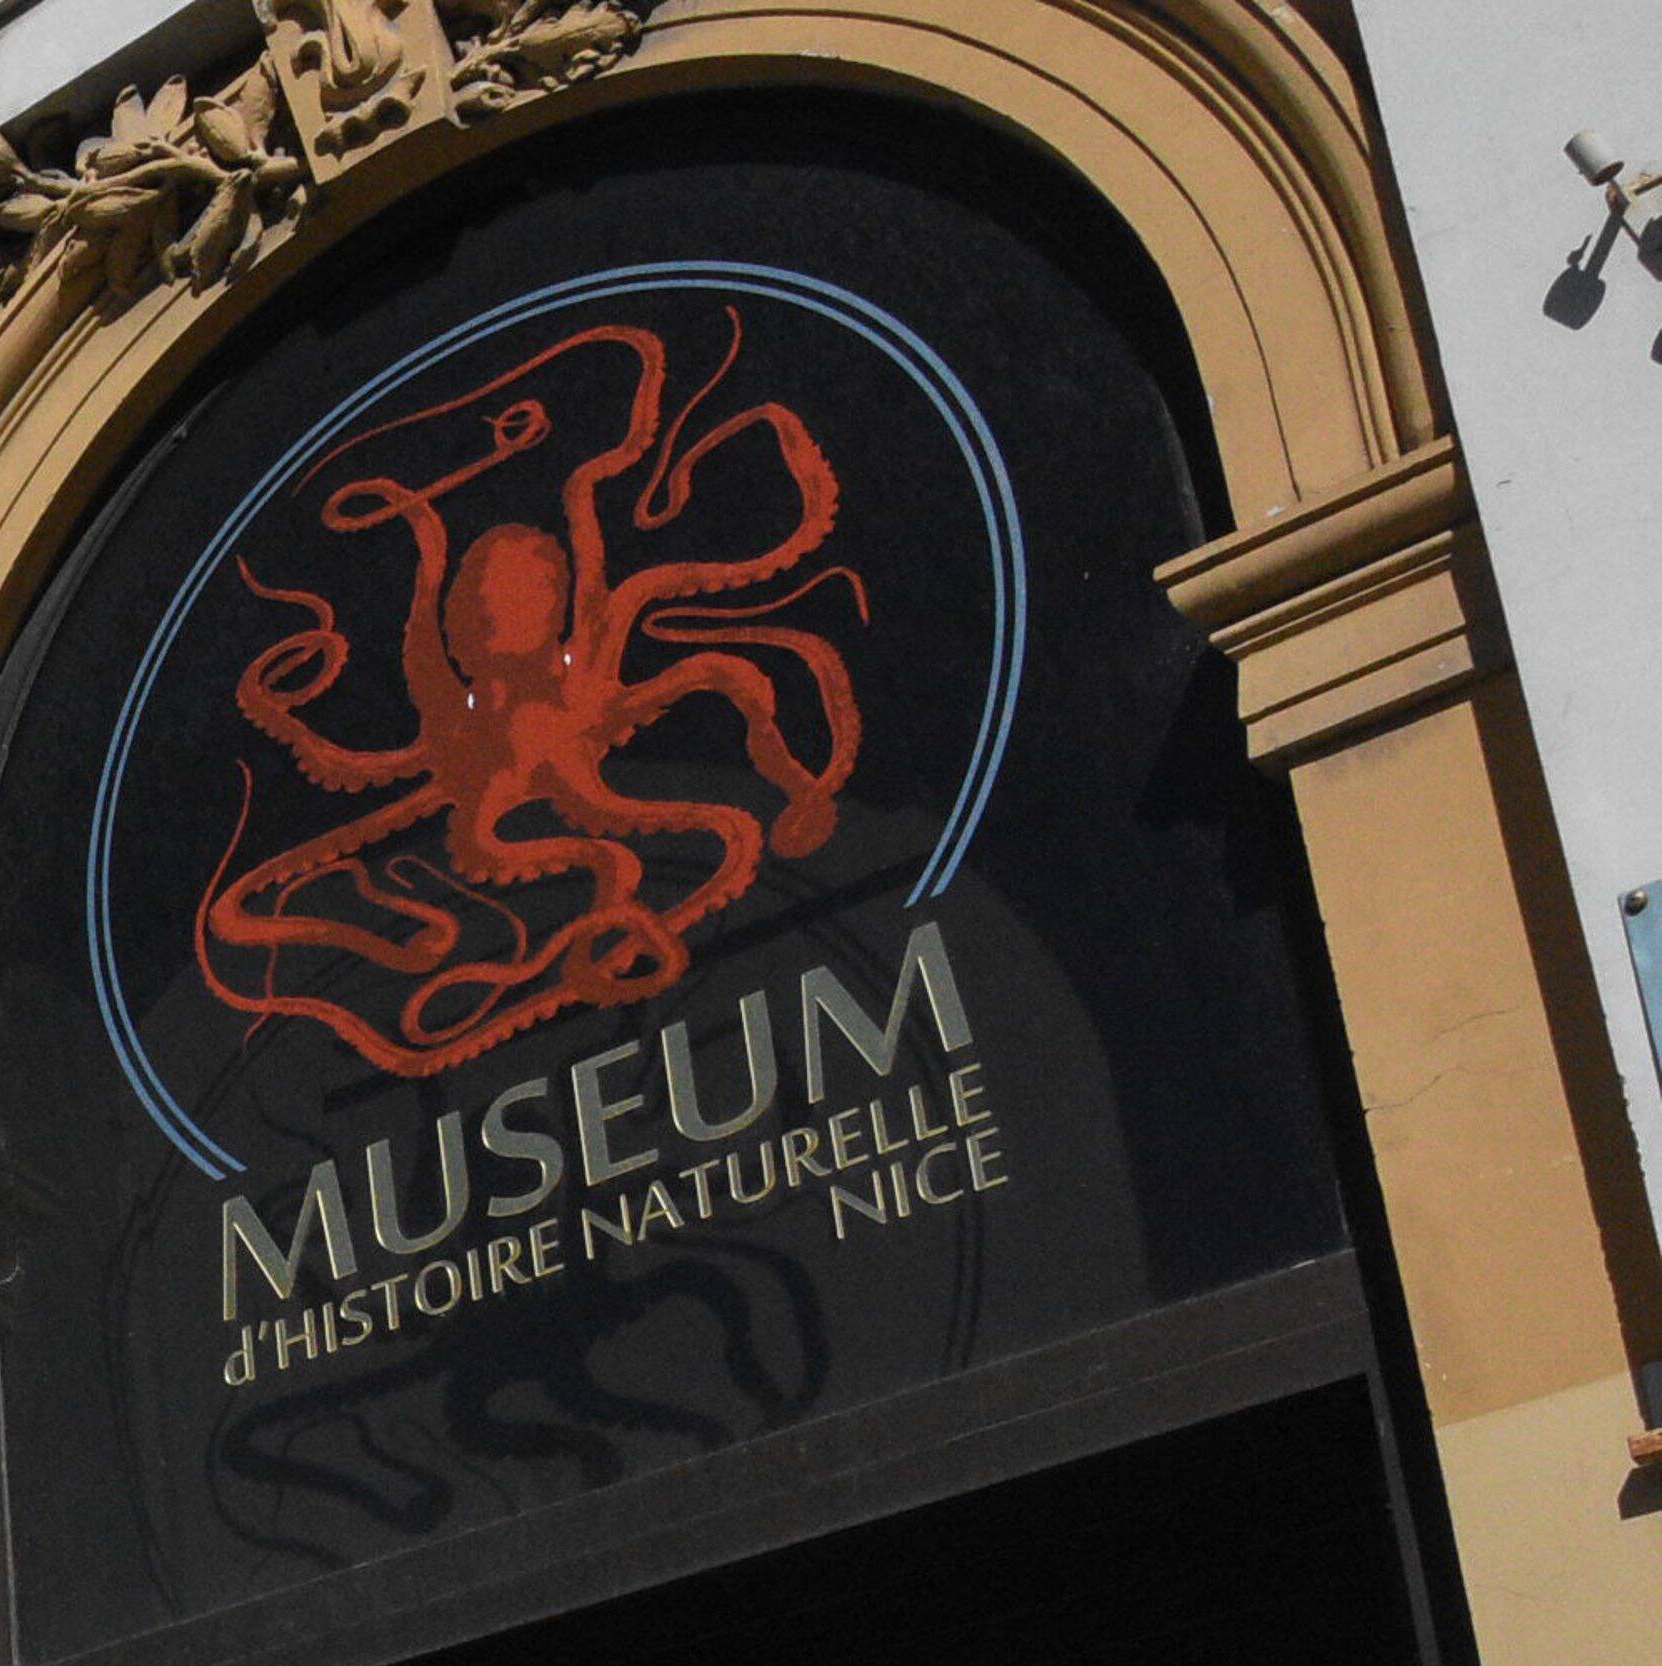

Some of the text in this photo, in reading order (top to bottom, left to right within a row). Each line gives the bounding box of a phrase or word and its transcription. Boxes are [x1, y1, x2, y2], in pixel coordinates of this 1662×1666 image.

[222, 921, 974, 1320] MUSEUM
[222, 1063, 994, 1386] d'HISTOIRE NATURELLE
[828, 1127, 1008, 1239] NICE
